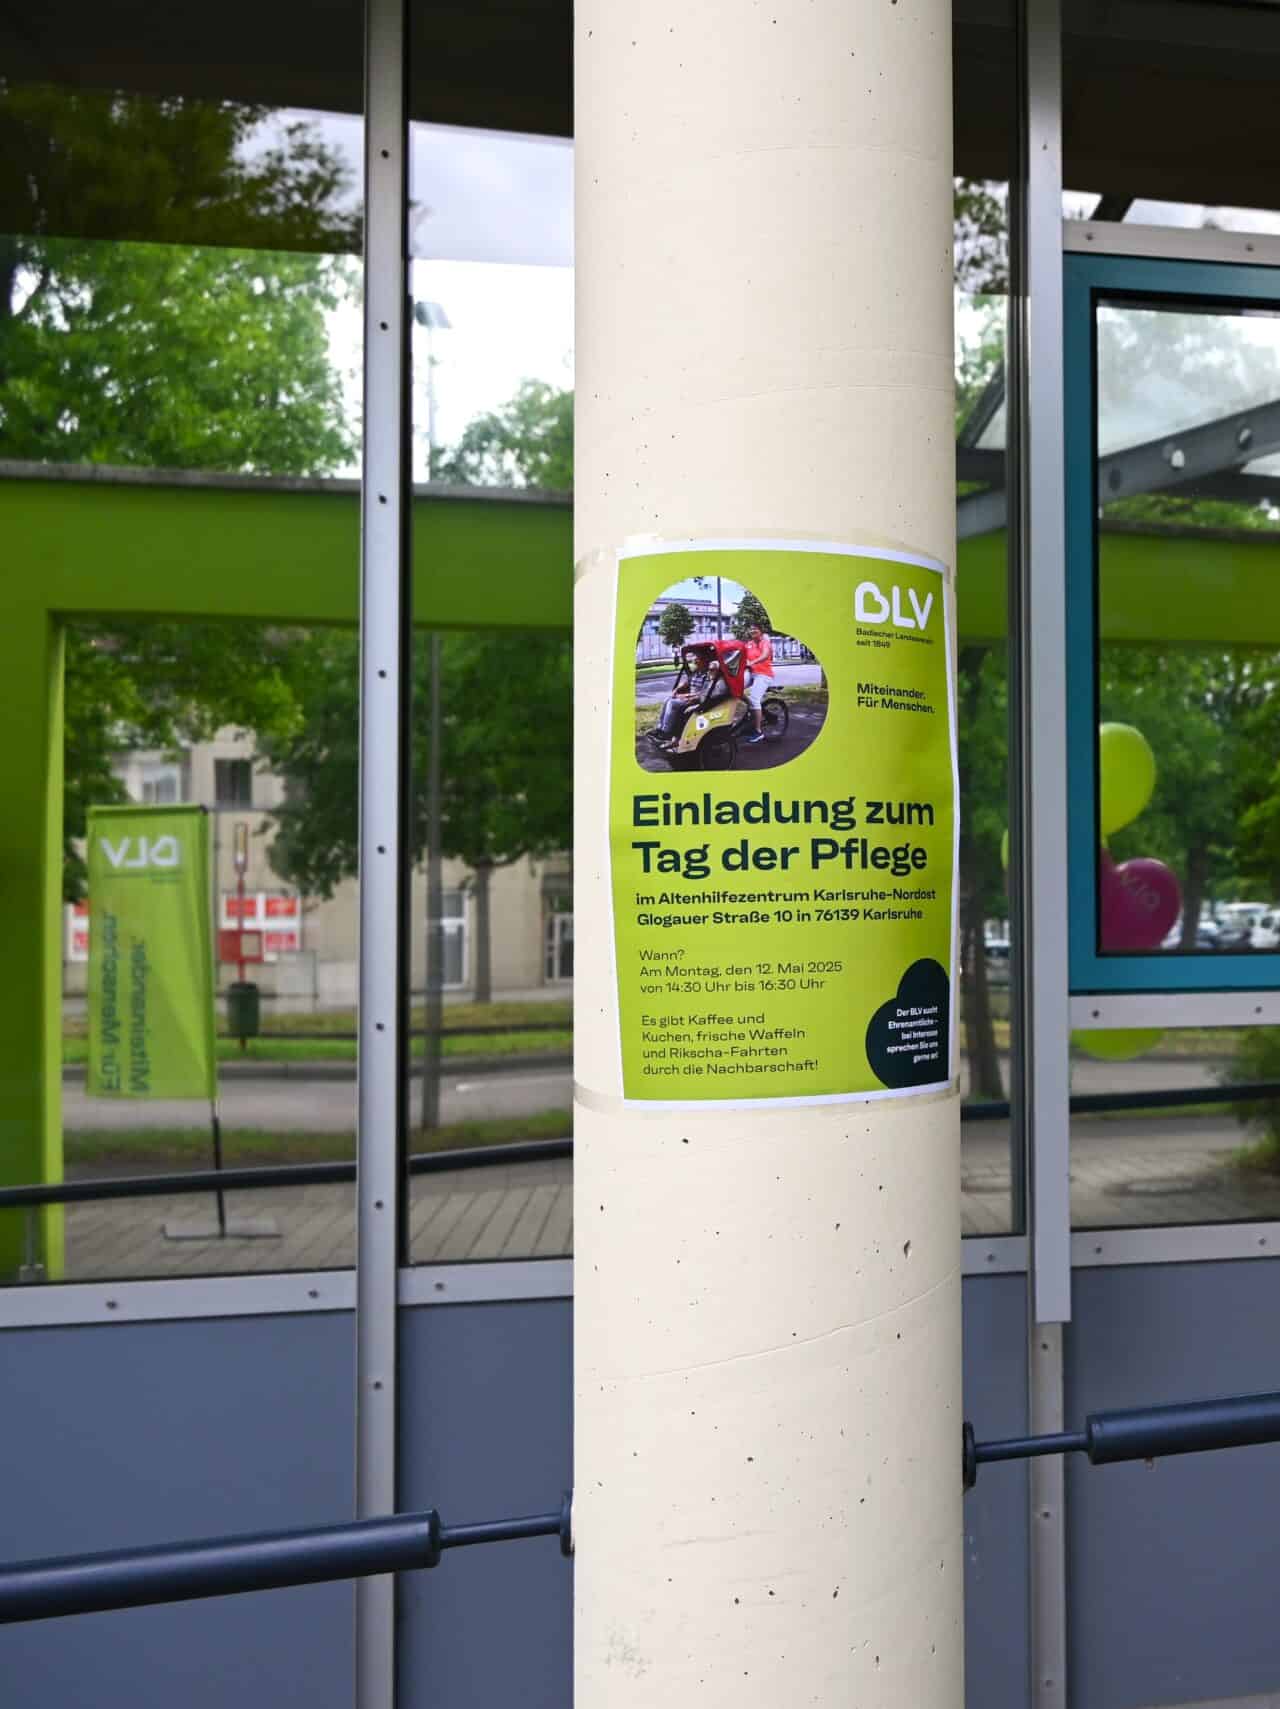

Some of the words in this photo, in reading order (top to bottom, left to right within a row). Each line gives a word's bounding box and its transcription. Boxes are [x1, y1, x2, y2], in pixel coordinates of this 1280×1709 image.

[855, 581, 934, 630] BLV
[857, 683, 926, 700] Miteinander.
[857, 697, 879, 708] Für
[881, 698, 936, 714] Menschen.
[633, 792, 856, 831] Einladung
[865, 801, 935, 826] zum
[631, 841, 711, 879] Tag
[721, 839, 799, 871] der
[811, 838, 928, 877] Pflege
[636, 892, 655, 905] im
[658, 889, 810, 905] Altenhilfezentrum
[813, 888, 936, 901] Karlsruhe-Nordost
[637, 912, 709, 928] Glogauer
[712, 910, 770, 924] Straße
[774, 910, 793, 922] 10
[796, 909, 812, 922] in
[814, 908, 859, 922] 76139
[863, 907, 923, 921] Karlsruhe
[639, 950, 685, 961] Wann?
[639, 966, 662, 977] Am
[665, 966, 722, 979] Montag,
[725, 964, 752, 975] den
[756, 963, 773, 974] 12.
[777, 963, 804, 974] Mai
[808, 961, 843, 973] 2025
[640, 984, 663, 994] von
[666, 982, 701, 993] 14:30
[705, 981, 731, 992] Uhr
[734, 980, 755, 991] bis
[759, 979, 796, 991] 16:30
[800, 978, 825, 989] Uhr
[641, 1015, 656, 1026] Es
[659, 1015, 684, 1028] gibt
[688, 1014, 734, 1025] Kaffee
[737, 1013, 765, 1024] und
[642, 1031, 694, 1043] Kuchen,
[696, 1029, 745, 1041] frische
[749, 1028, 805, 1040] Waffeln
[643, 1048, 666, 1058] und
[670, 1046, 788, 1058] Rikscha-Fahrten
[643, 1064, 680, 1075] durch
[683, 1063, 703, 1075] die
[707, 1060, 818, 1075] Nachbarschaft!
